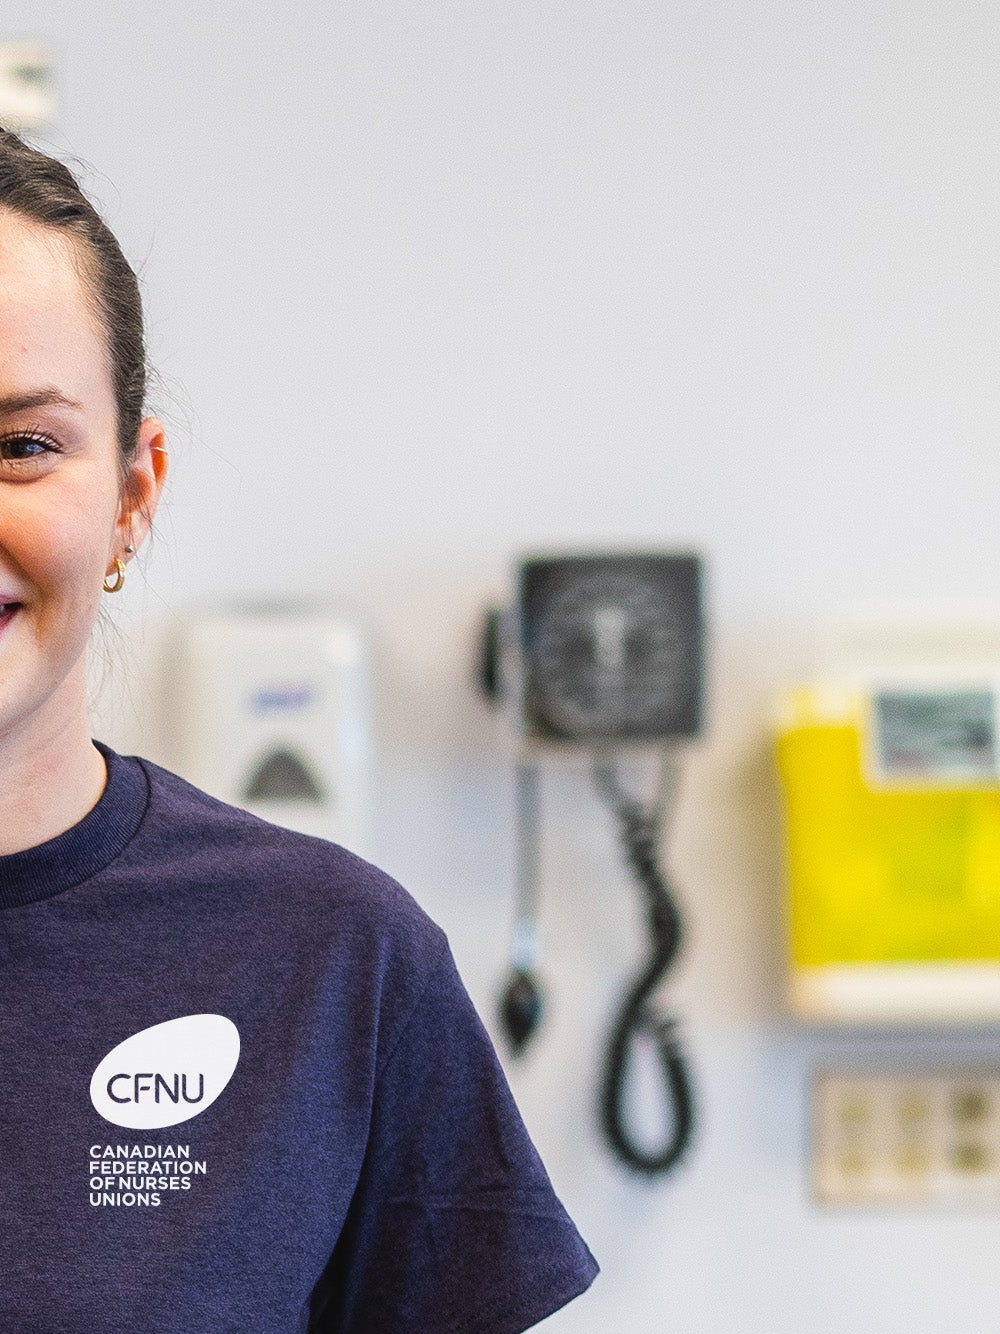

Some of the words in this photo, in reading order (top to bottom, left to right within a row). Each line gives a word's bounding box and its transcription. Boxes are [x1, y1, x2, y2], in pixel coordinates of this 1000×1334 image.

[107, 1073, 204, 1104] CFNU
[89, 1144, 190, 1159] CANADIAN
[89, 1160, 207, 1175] FEDERATION
[89, 1176, 116, 1190] OF
[118, 1176, 192, 1190] NURSES
[89, 1192, 161, 1207] UNIONS
